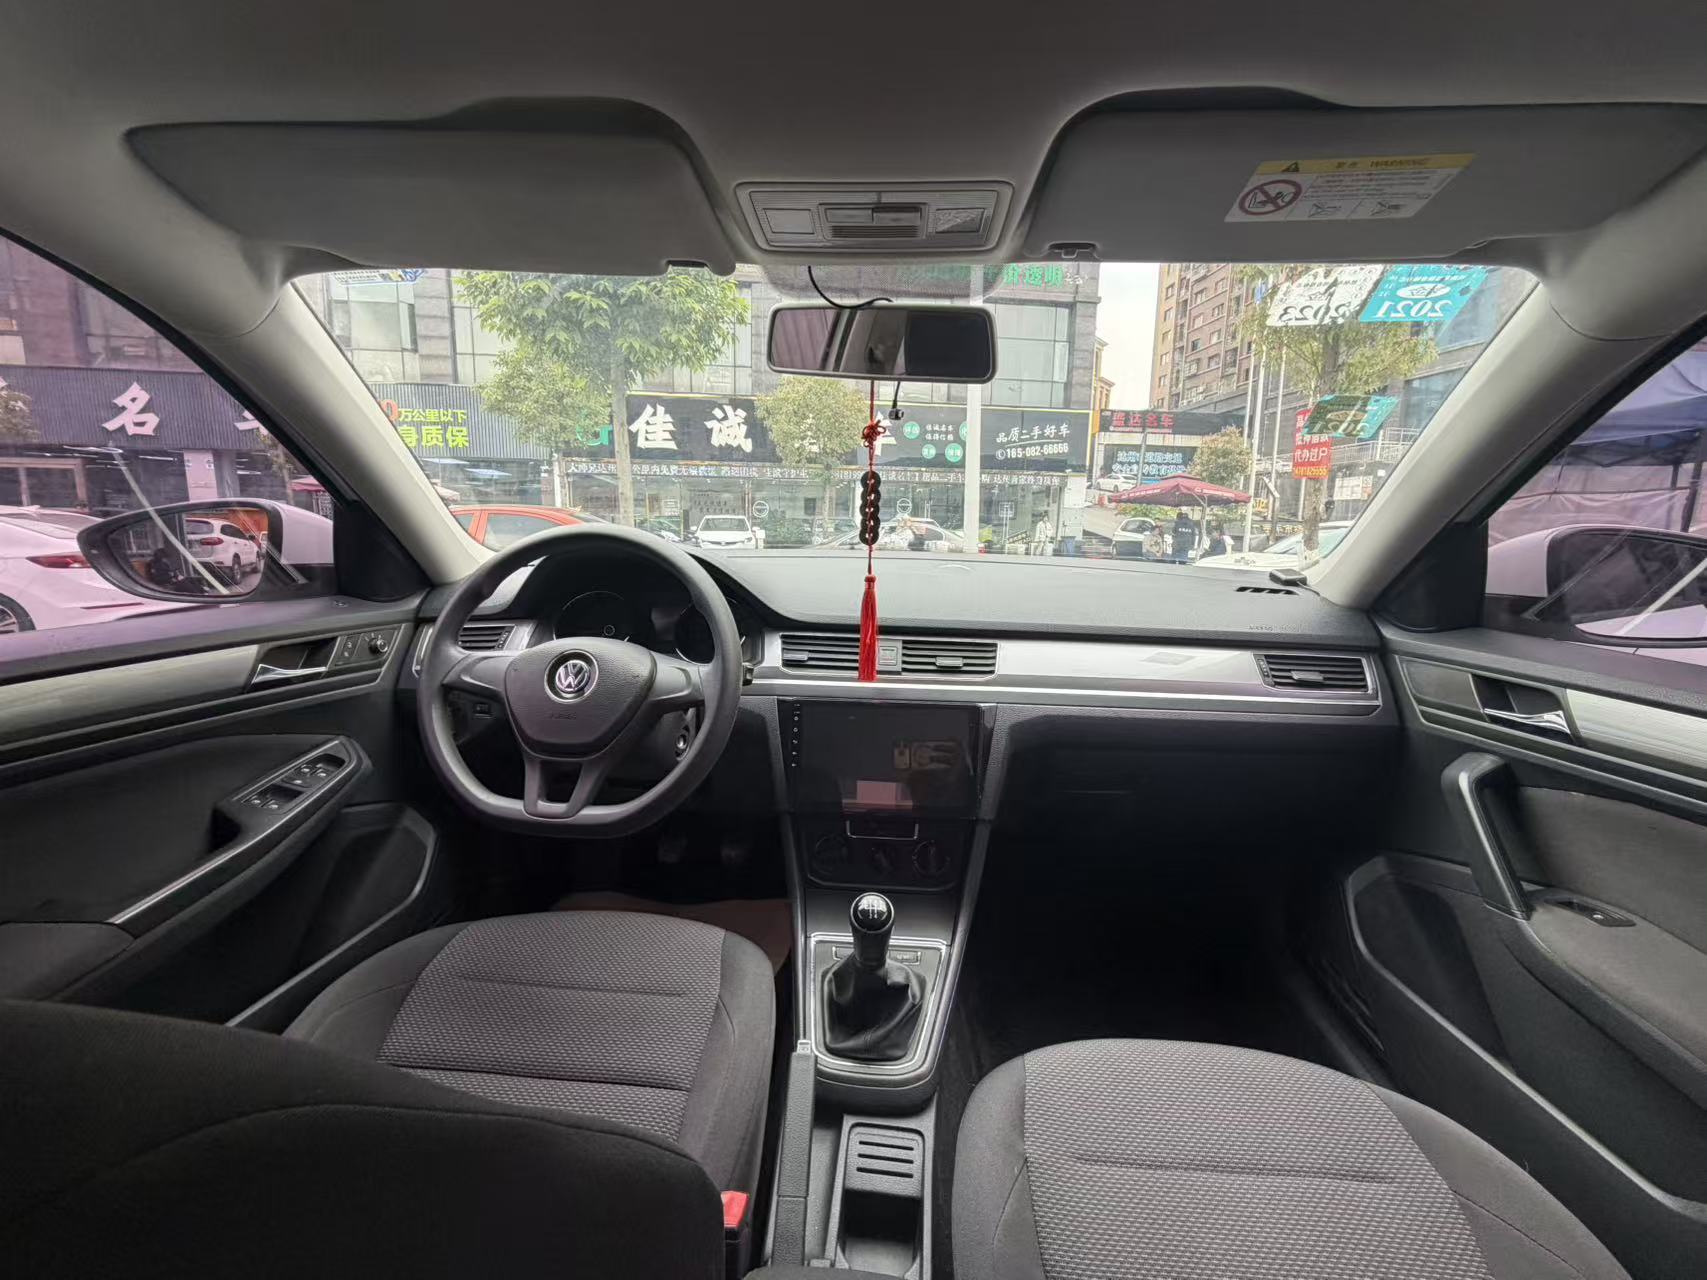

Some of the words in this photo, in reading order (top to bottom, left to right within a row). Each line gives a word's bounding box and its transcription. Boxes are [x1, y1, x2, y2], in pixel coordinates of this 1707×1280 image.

[995, 422, 1071, 443] 品质二手好车
